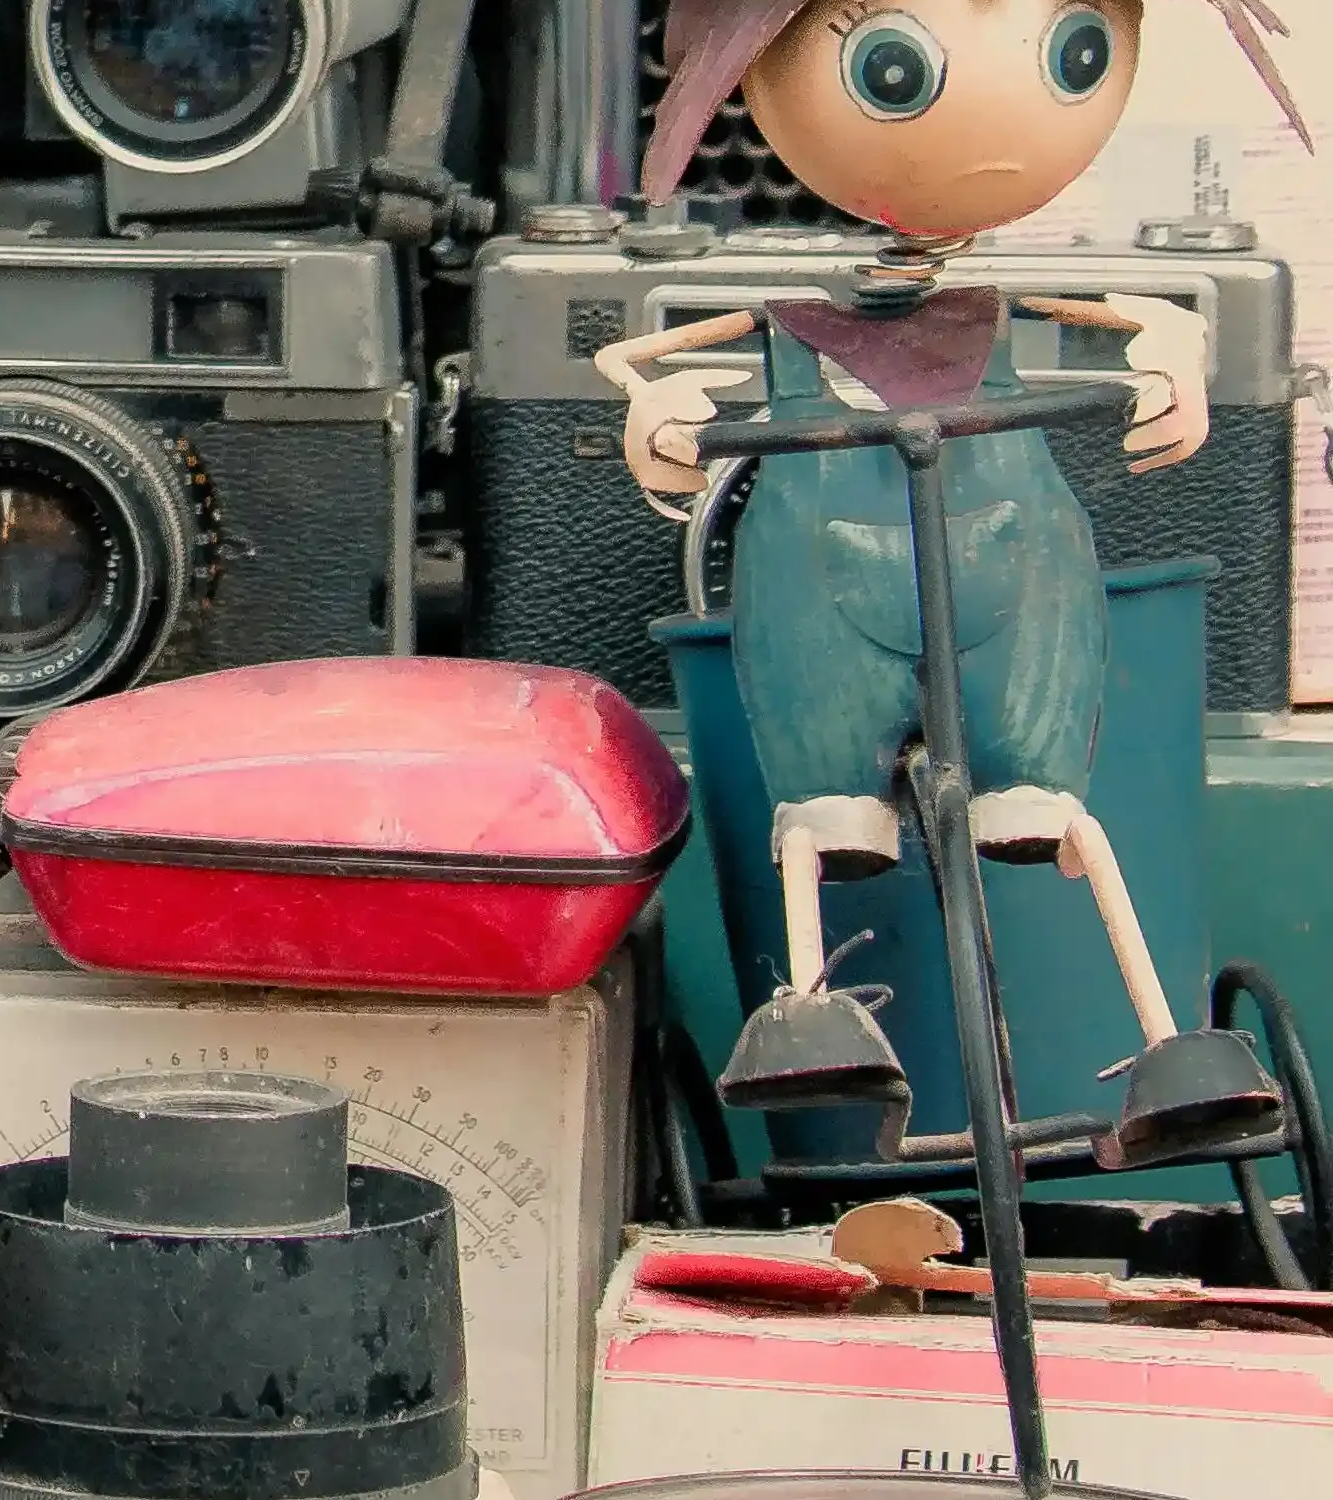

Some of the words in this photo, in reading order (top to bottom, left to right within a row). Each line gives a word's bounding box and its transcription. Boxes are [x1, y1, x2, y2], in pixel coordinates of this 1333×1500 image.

[253, 1045, 271, 1063] 10
[362, 1065, 385, 1084] 20
[411, 1083, 433, 1103] 30
[457, 1110, 480, 1132] 50
[464, 1427, 524, 1442] ESTER
